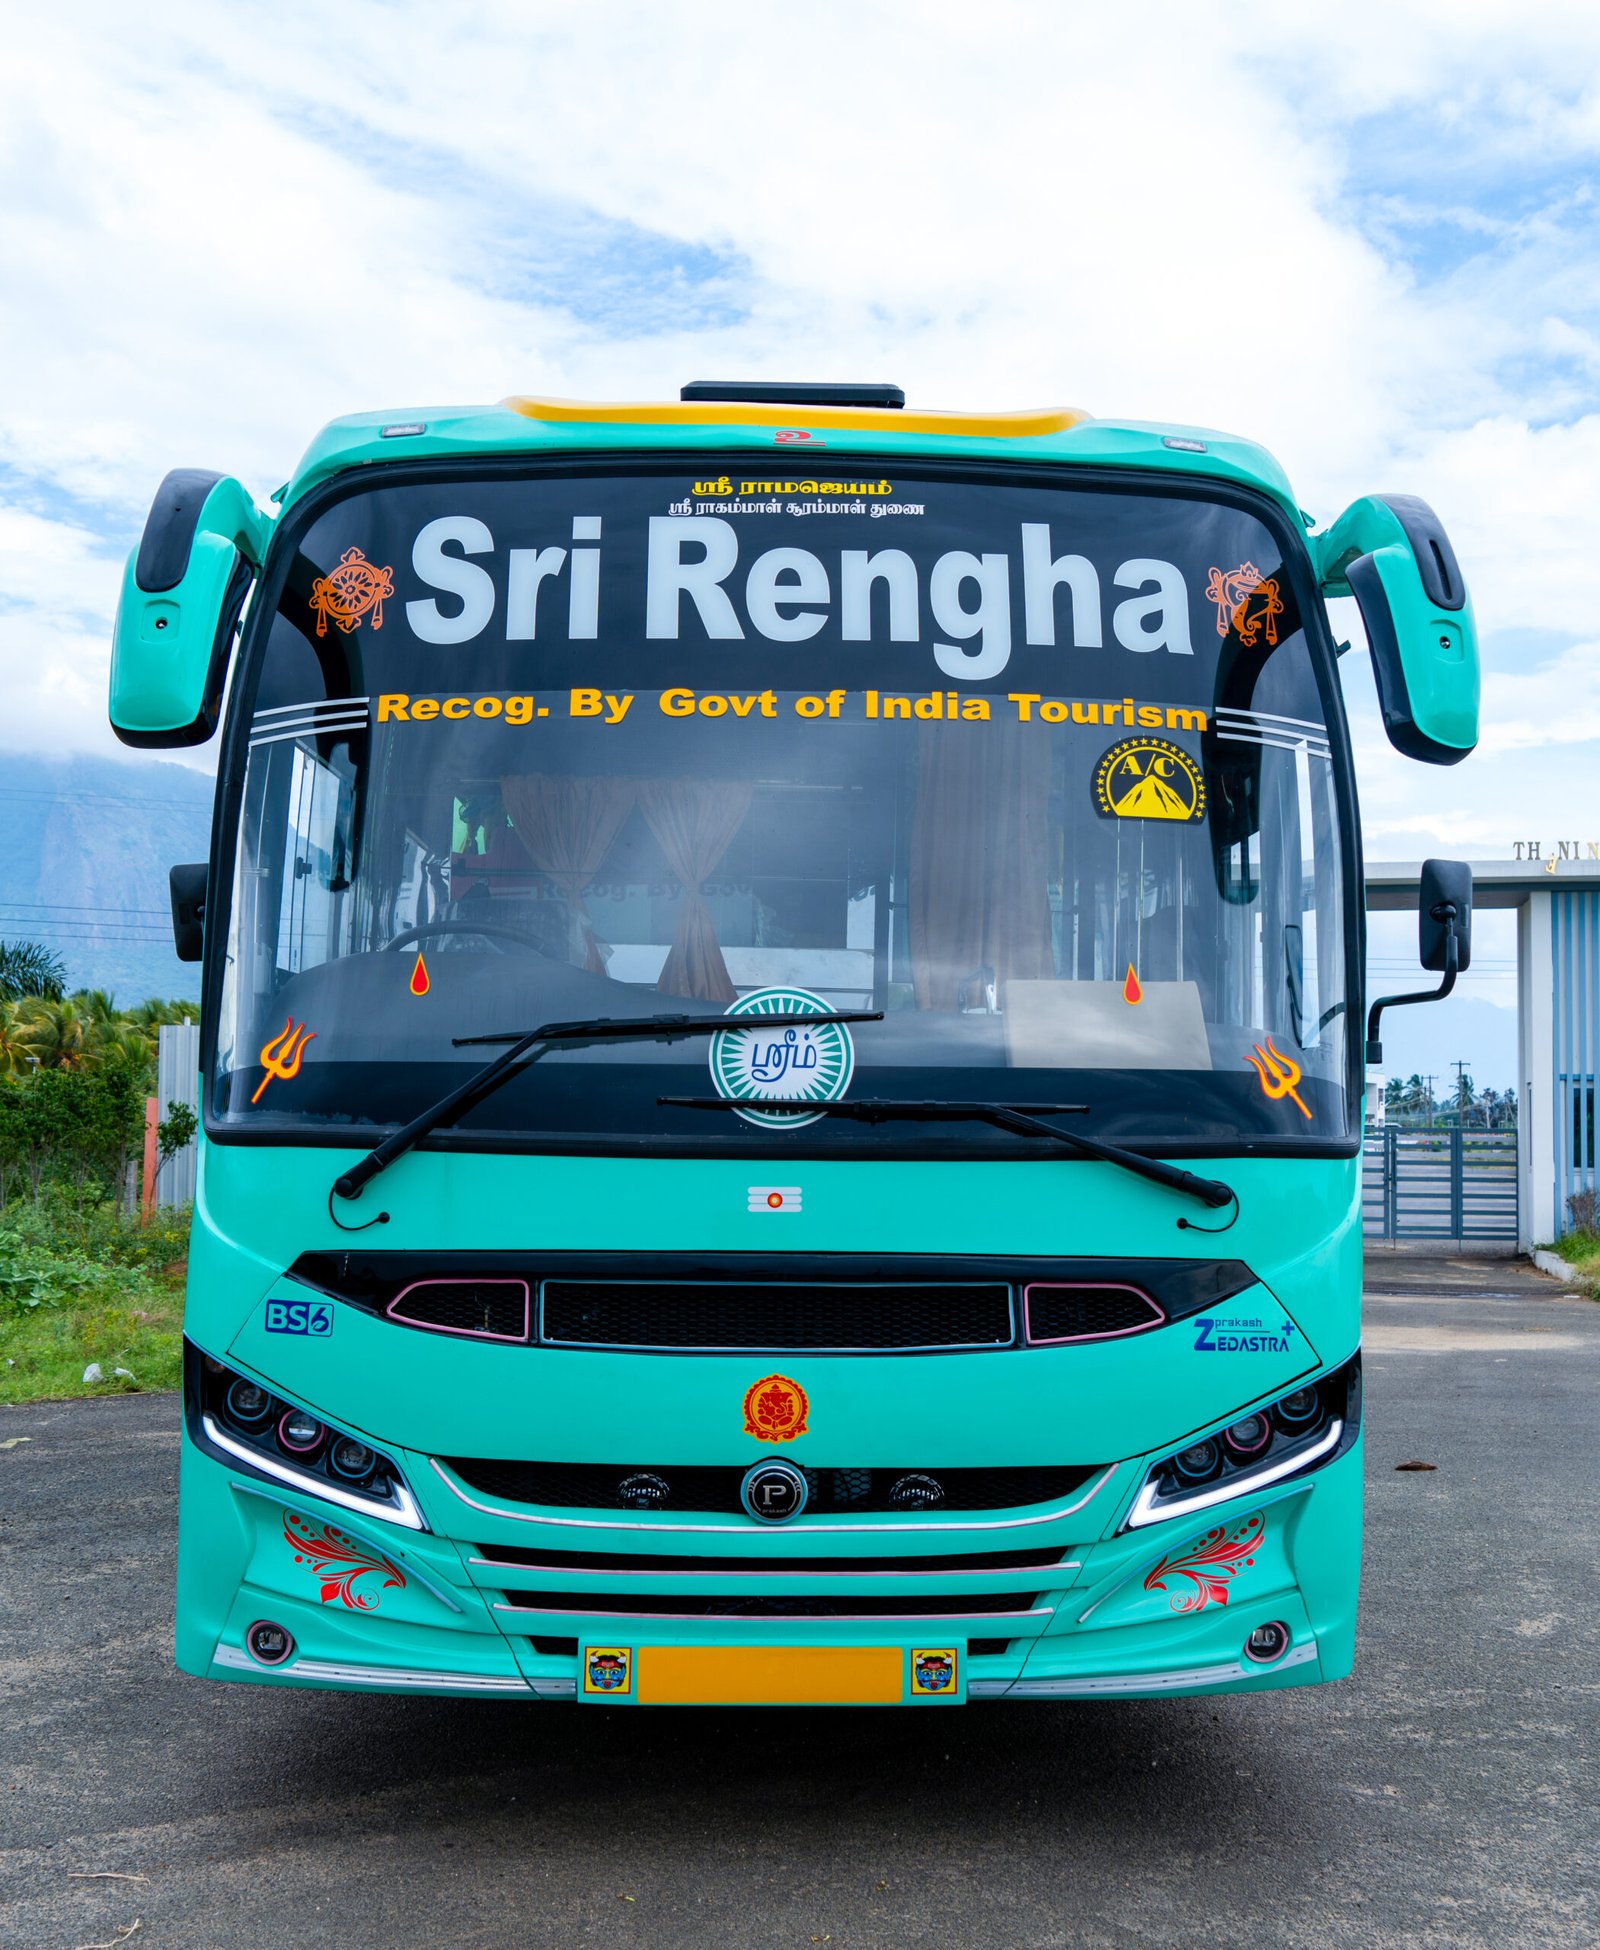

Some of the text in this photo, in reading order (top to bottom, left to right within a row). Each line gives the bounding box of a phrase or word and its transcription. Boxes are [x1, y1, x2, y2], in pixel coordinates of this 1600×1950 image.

[870, 503, 925, 518] துணை
[405, 515, 1195, 681] Sri Rengha
[377, 688, 1209, 733] Recog. By Govt of India Tourism
[1118, 753, 1177, 779] A/C
[266, 1303, 330, 1333] BS6
[1215, 1317, 1262, 1329] prakash
[762, 1484, 787, 1505] P
